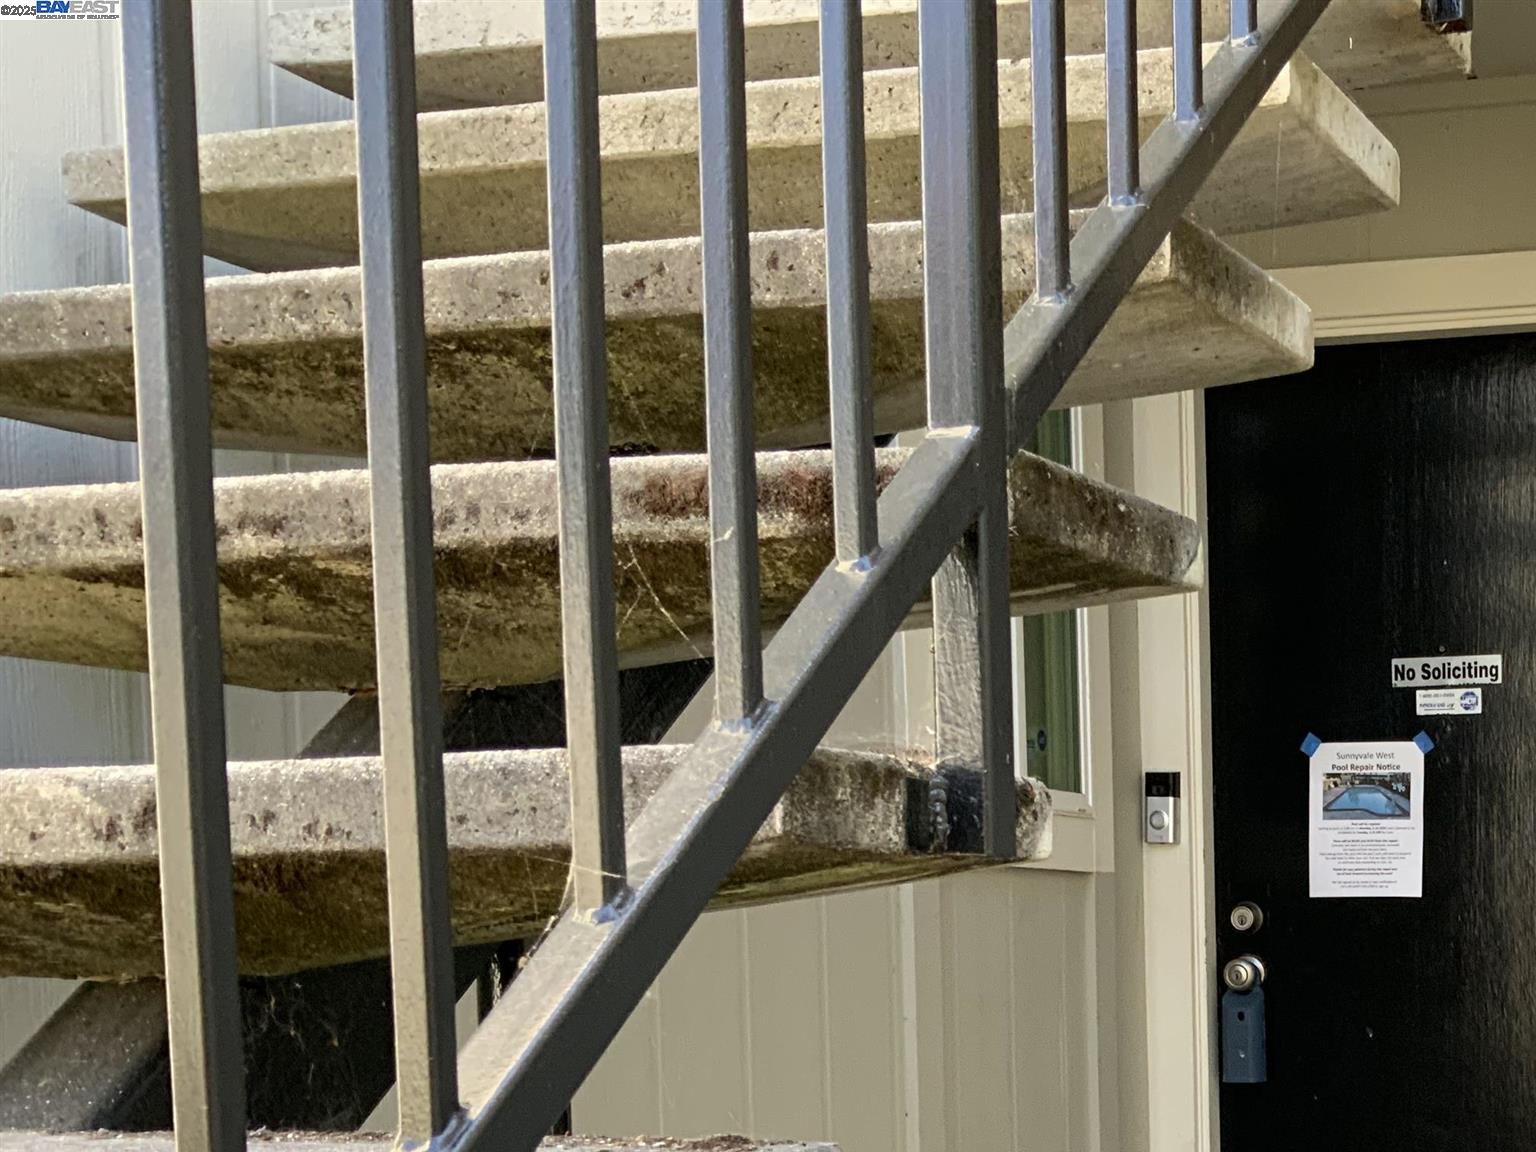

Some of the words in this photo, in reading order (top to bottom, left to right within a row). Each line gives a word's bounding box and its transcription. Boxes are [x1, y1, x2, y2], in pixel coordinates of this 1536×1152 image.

[1394, 664, 1416, 681] No
[1421, 661, 1499, 682] Soliciting
[1336, 752, 1374, 761] Sunnyvale
[1376, 752, 1395, 760] West
[1331, 763, 1349, 771] Pool
[1350, 763, 1374, 772] Repair
[1376, 763, 1401, 771] Notice
